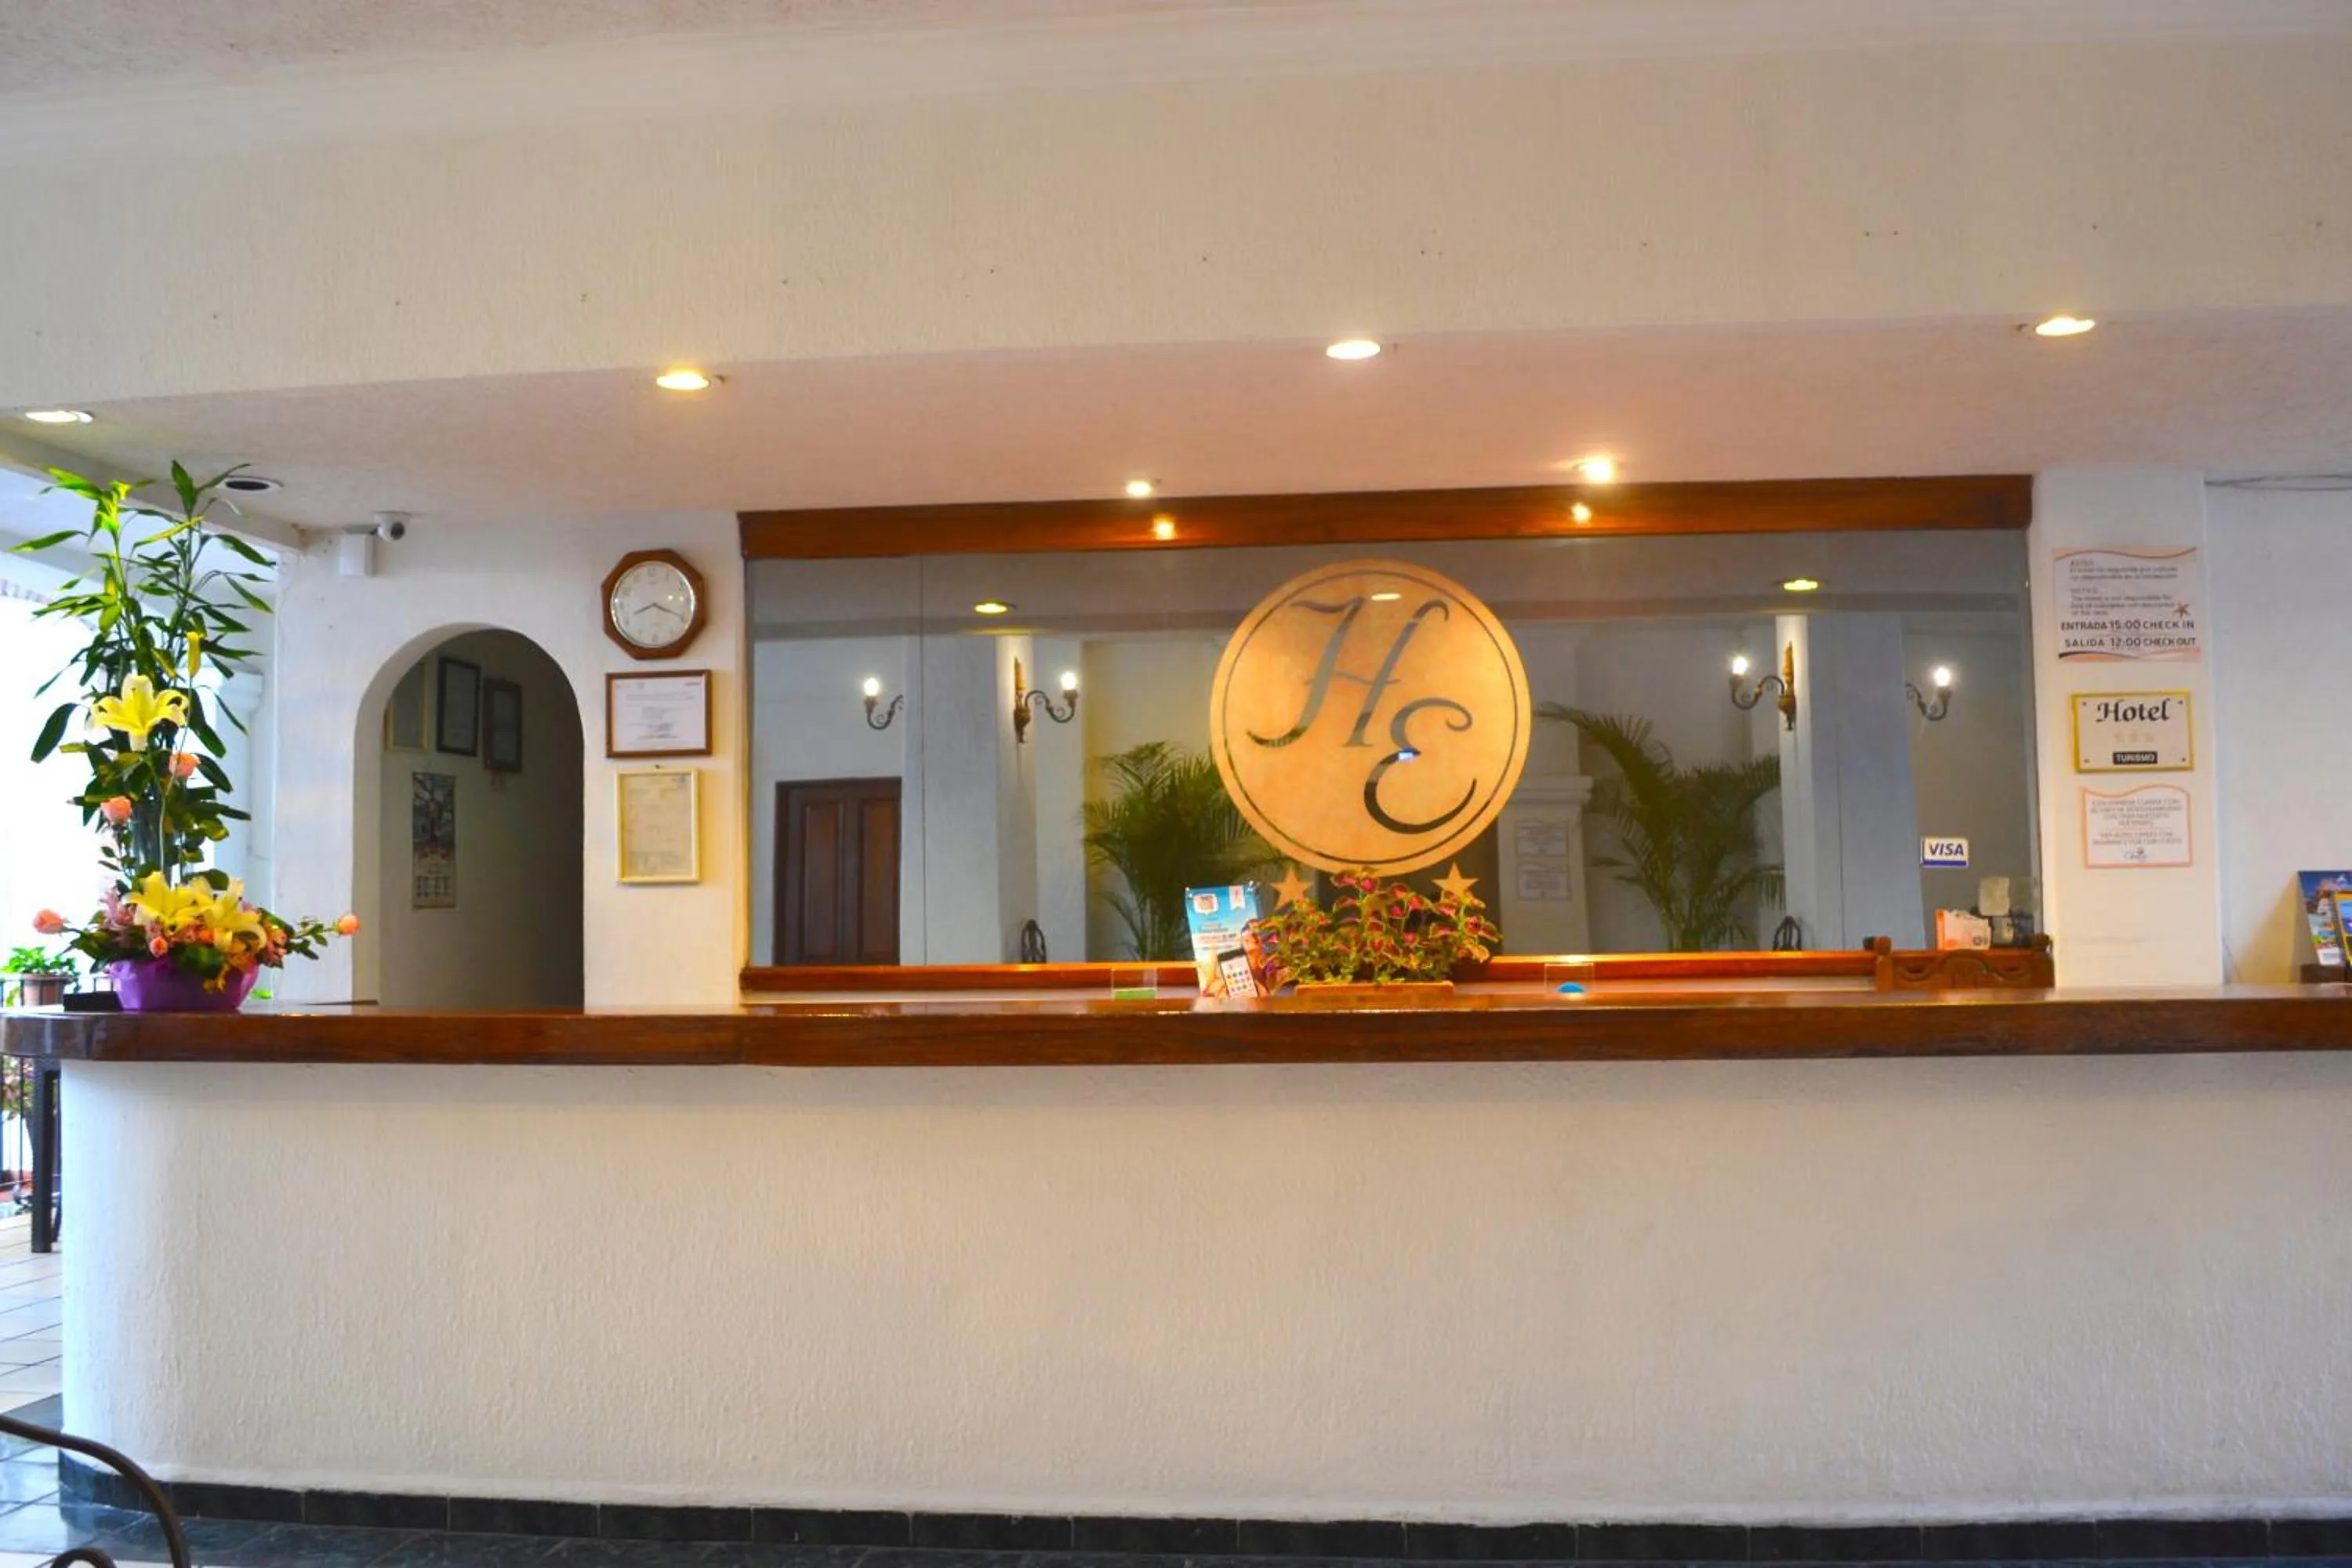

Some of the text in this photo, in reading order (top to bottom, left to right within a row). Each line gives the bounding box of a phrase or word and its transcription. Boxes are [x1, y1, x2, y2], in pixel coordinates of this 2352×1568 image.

[2060, 620, 2107, 630] ENTRADA
[2143, 619, 2179, 630] CHECK
[2181, 619, 2194, 630] IN
[2064, 638, 2105, 648] SALIDA
[2143, 637, 2175, 647] CHECK
[2176, 637, 2196, 646] OUT
[2096, 698, 2171, 723] Hotel
[1929, 842, 1965, 856] VISA
